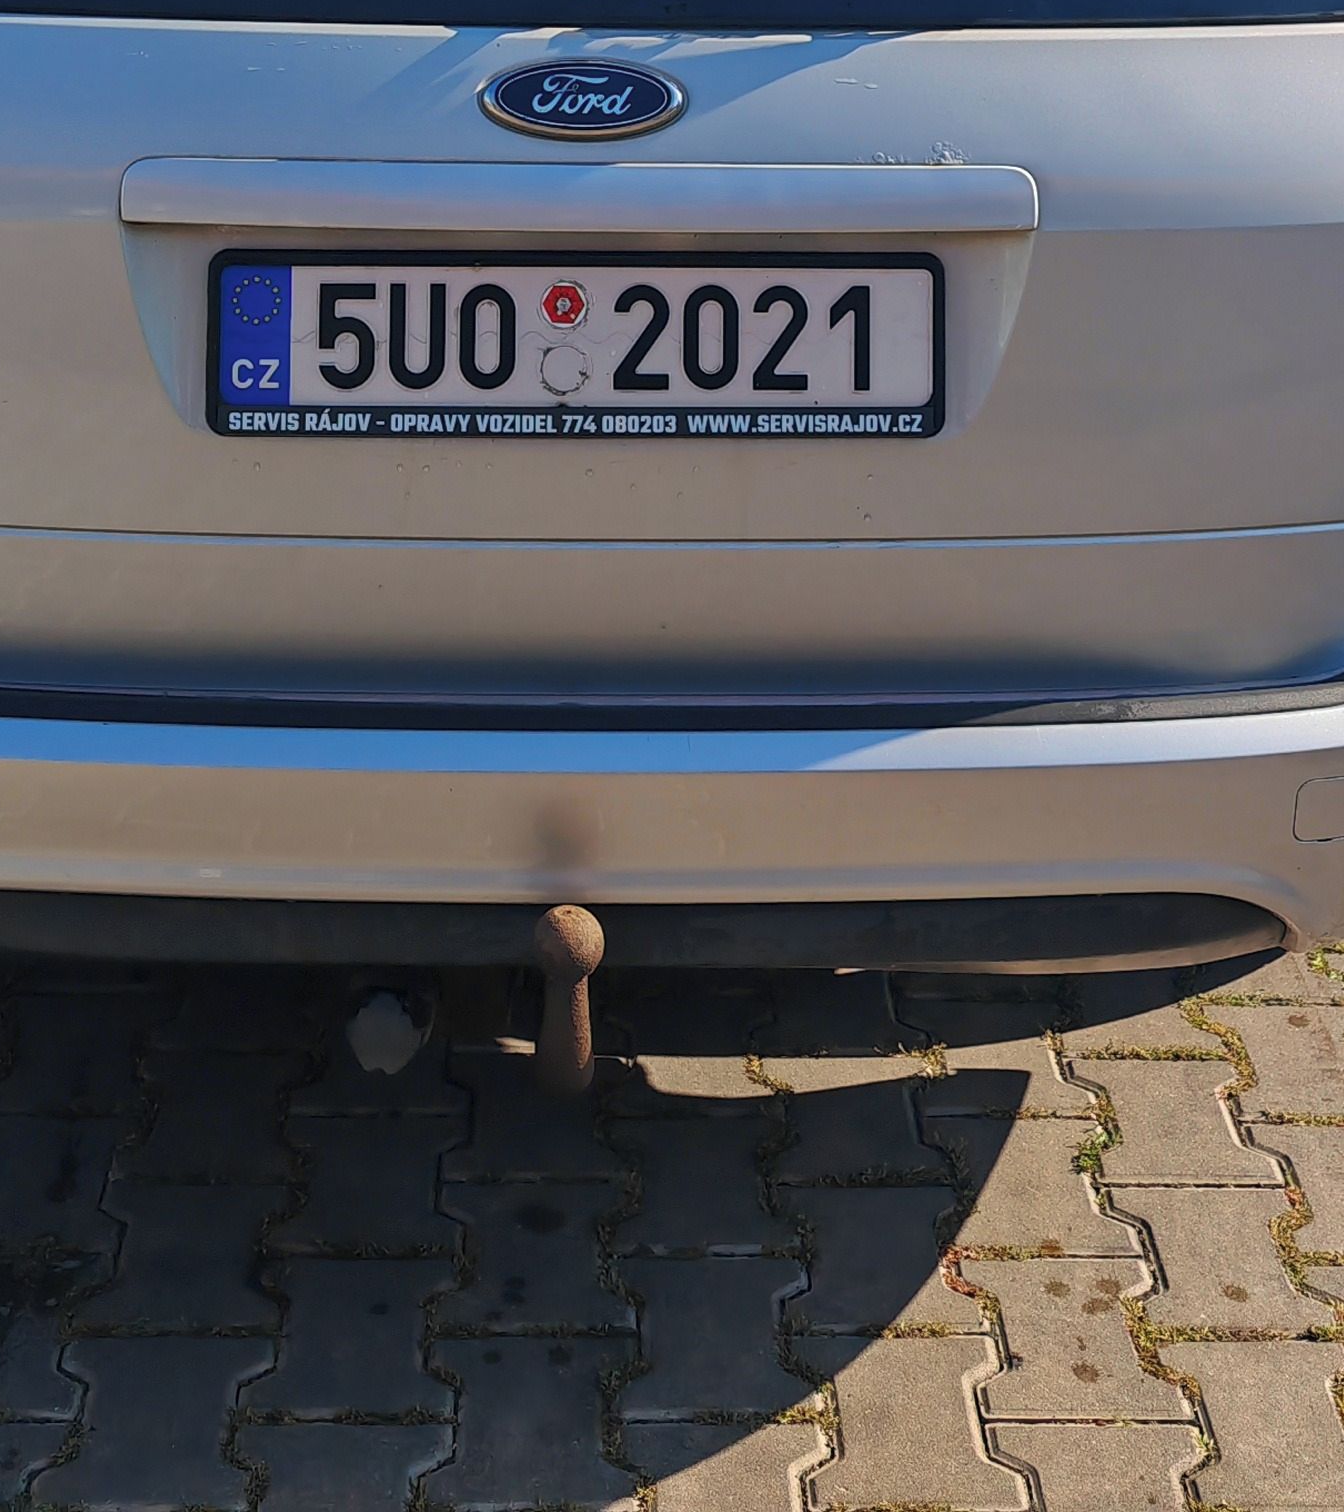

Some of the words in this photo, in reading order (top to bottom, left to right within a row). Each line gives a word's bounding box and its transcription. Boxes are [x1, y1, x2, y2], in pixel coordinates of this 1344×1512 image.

[531, 73, 634, 116] Ford
[612, 284, 871, 391] 2021
[231, 359, 281, 389] CZ
[228, 412, 300, 432] SERVIS
[305, 408, 372, 432] RÁJOV
[390, 413, 471, 433] OPRAVY
[477, 414, 558, 434] VOZIDEL
[561, 415, 597, 433] 774
[601, 414, 677, 434] 080203
[687, 413, 923, 434] WWW.SERVISRAJOV.CZ
